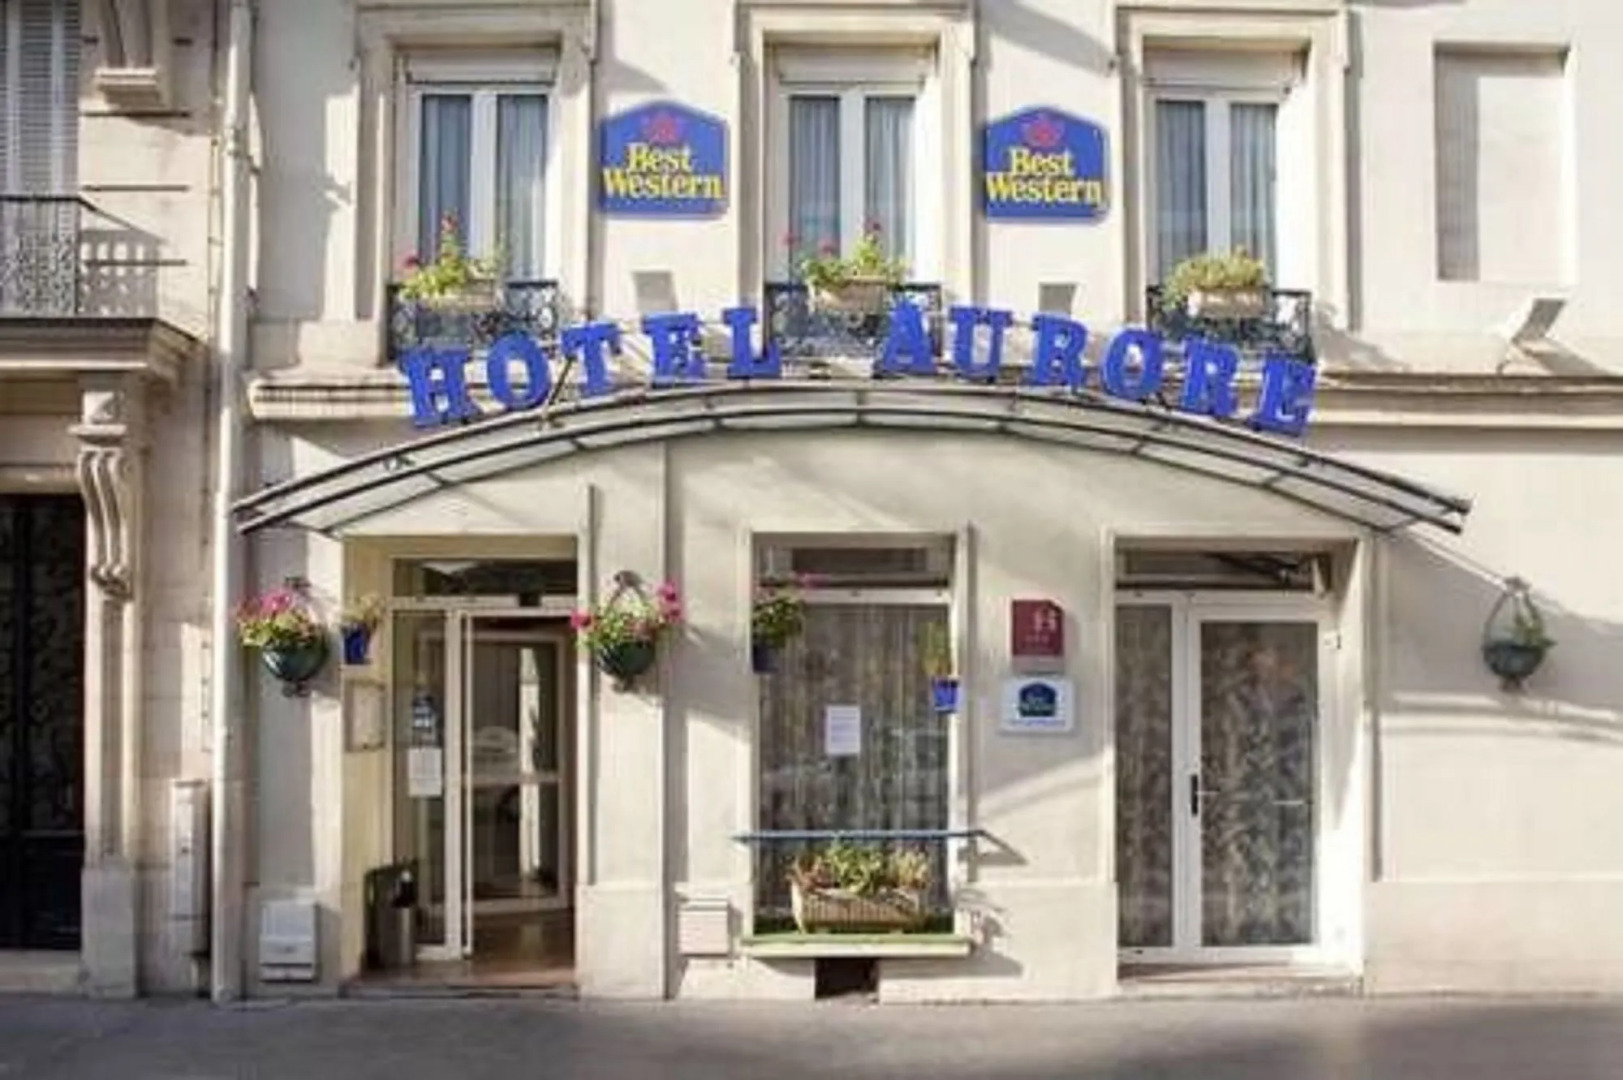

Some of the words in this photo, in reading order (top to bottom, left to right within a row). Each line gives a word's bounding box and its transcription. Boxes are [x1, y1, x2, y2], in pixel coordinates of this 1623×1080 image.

[626, 142, 692, 173] Best
[1010, 147, 1074, 176] Best
[602, 168, 723, 199] Western
[987, 172, 1101, 204] Western
[401, 307, 782, 425] HOTEL
[873, 301, 1317, 435] AURORE
